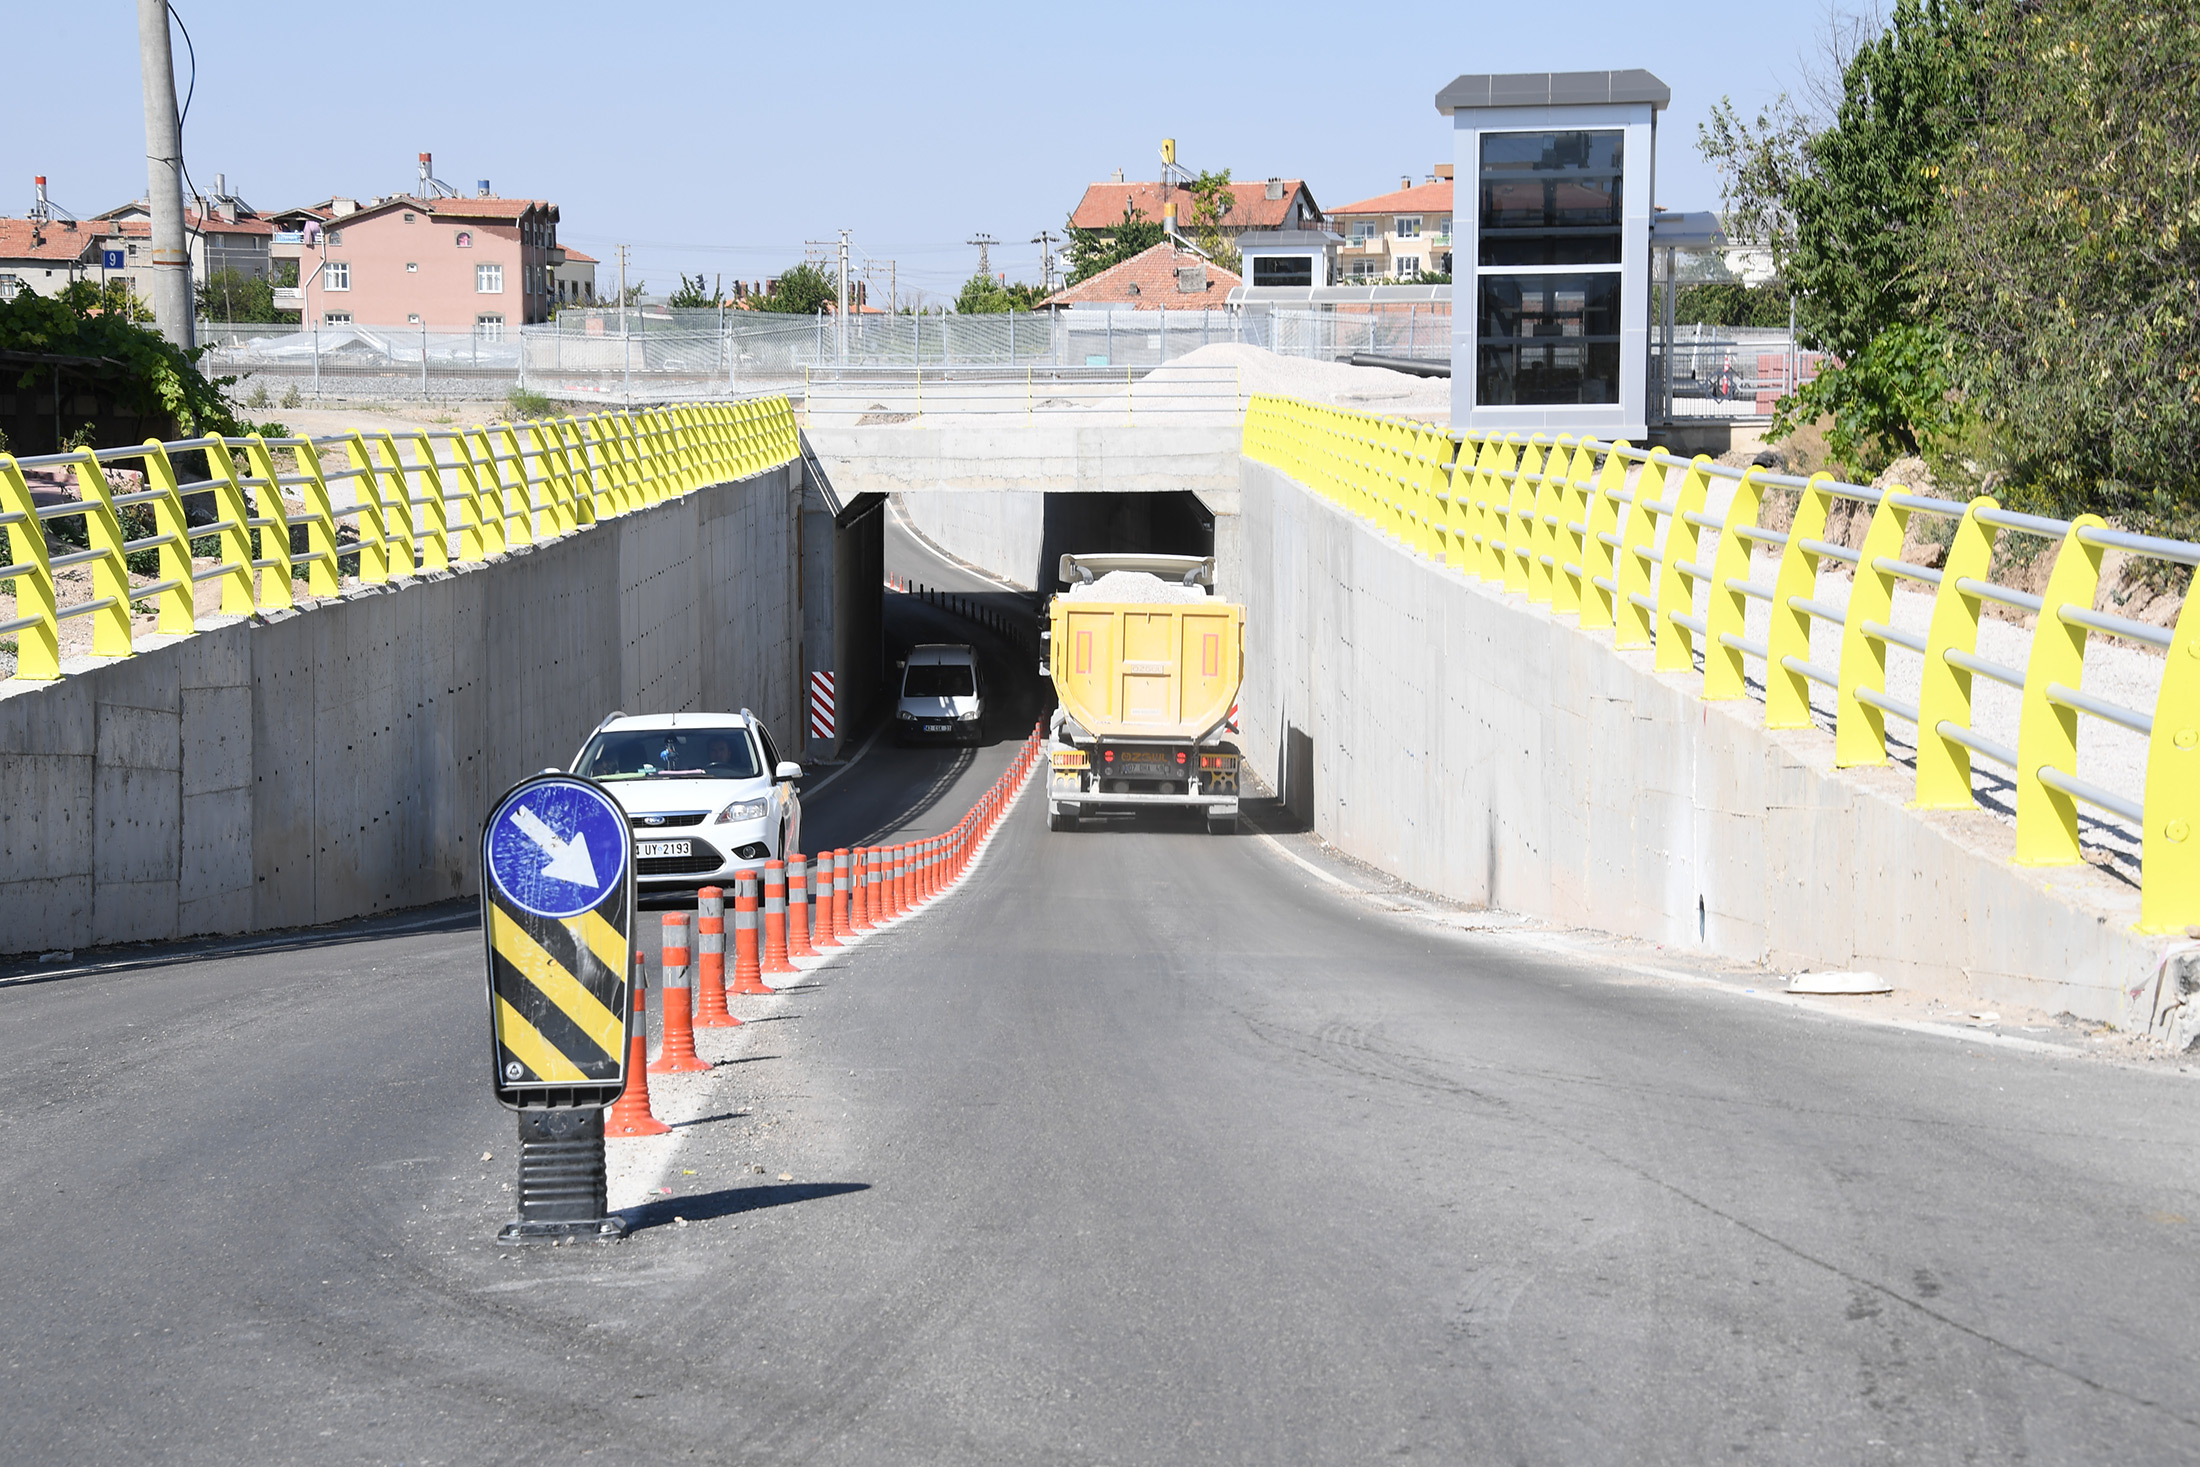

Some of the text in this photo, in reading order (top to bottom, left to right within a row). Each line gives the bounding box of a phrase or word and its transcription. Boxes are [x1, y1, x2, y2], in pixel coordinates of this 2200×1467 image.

[109, 252, 116, 267] 9
[644, 844, 658, 855] UY
[663, 843, 689, 855] 2193
